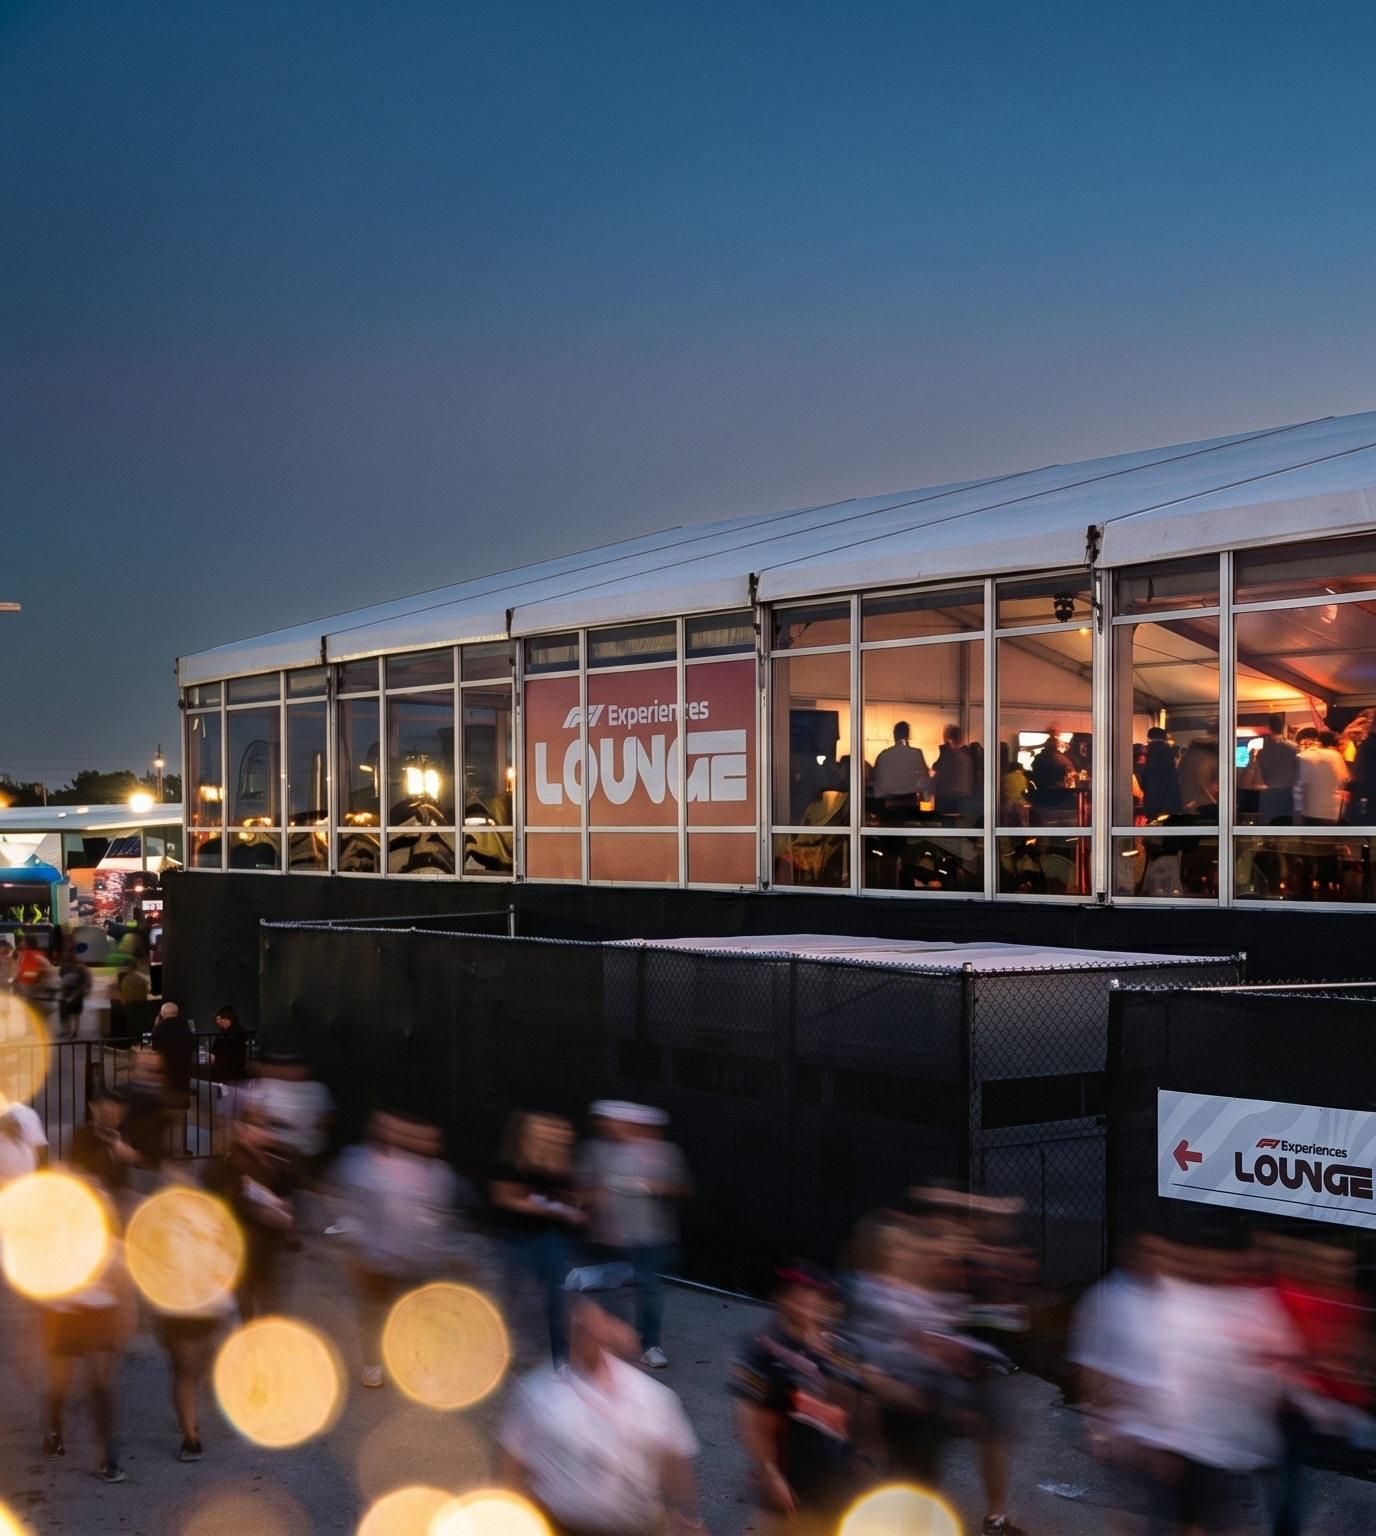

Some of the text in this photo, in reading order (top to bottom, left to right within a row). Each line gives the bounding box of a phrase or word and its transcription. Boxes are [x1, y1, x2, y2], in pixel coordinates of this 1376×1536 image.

[608, 699, 709, 730] Experienes
[535, 729, 747, 805] LOUNGE
[1281, 1140, 1348, 1159] Experiences
[1234, 1151, 1374, 1200] LOUNGE
